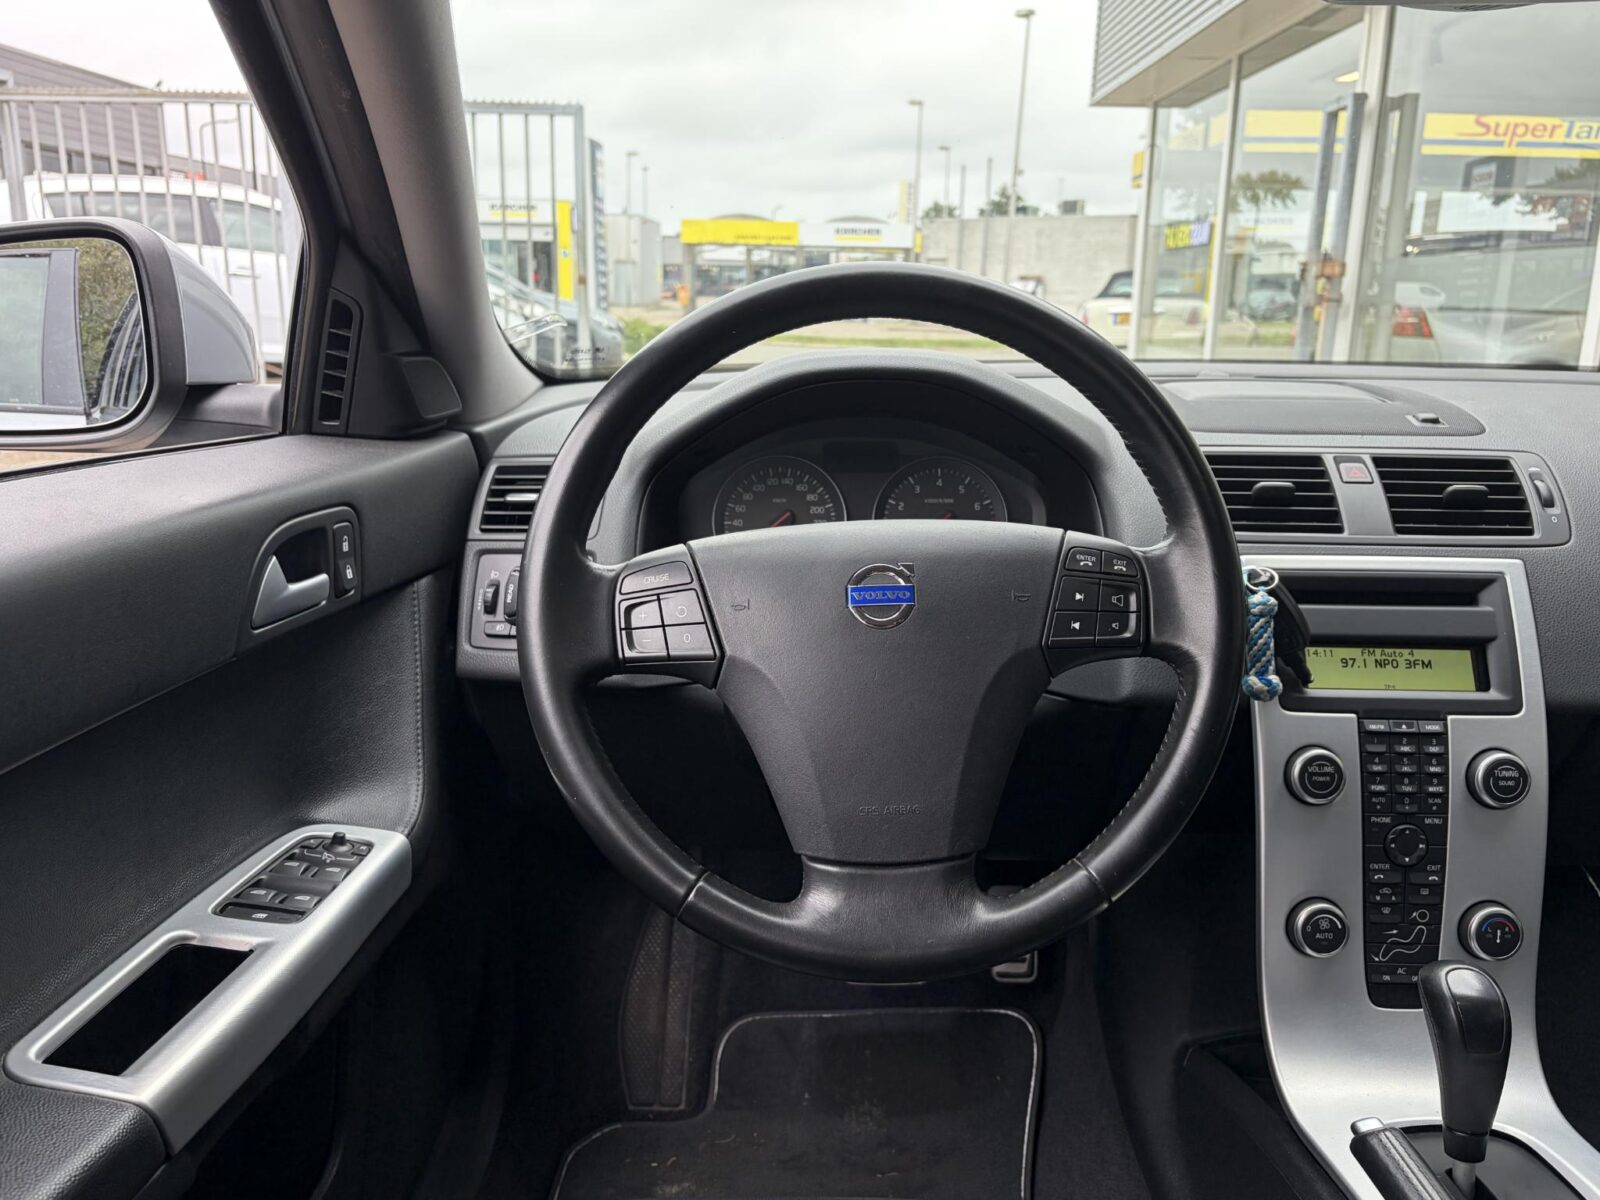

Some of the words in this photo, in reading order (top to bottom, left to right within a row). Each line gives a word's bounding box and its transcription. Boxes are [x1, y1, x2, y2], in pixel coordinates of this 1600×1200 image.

[936, 478, 943, 487] 4
[914, 485, 921, 494] 3
[958, 485, 965, 494] 5
[735, 504, 747, 513] 60
[809, 506, 825, 514] 200
[897, 502, 905, 511] 2
[974, 502, 981, 511] 6
[732, 519, 744, 527] 40
[1076, 554, 1096, 562] ENTER
[1113, 559, 1127, 567] EXIT
[643, 573, 670, 585] CRUISE
[851, 590, 911, 600] VOLVO
[1306, 649, 1334, 658] 14:11
[1361, 649, 1376, 657] FM
[1380, 650, 1404, 658] Auto
[1408, 650, 1415, 658] 4
[1341, 658, 1367, 668] 97.1
[1375, 659, 1399, 669] NPO
[1405, 660, 1432, 670] 3FM
[1494, 769, 1519, 778] TUNING
[883, 804, 921, 815] AIRBAG
[1370, 816, 1392, 824] PHONE
[1397, 967, 1407, 975] AC
